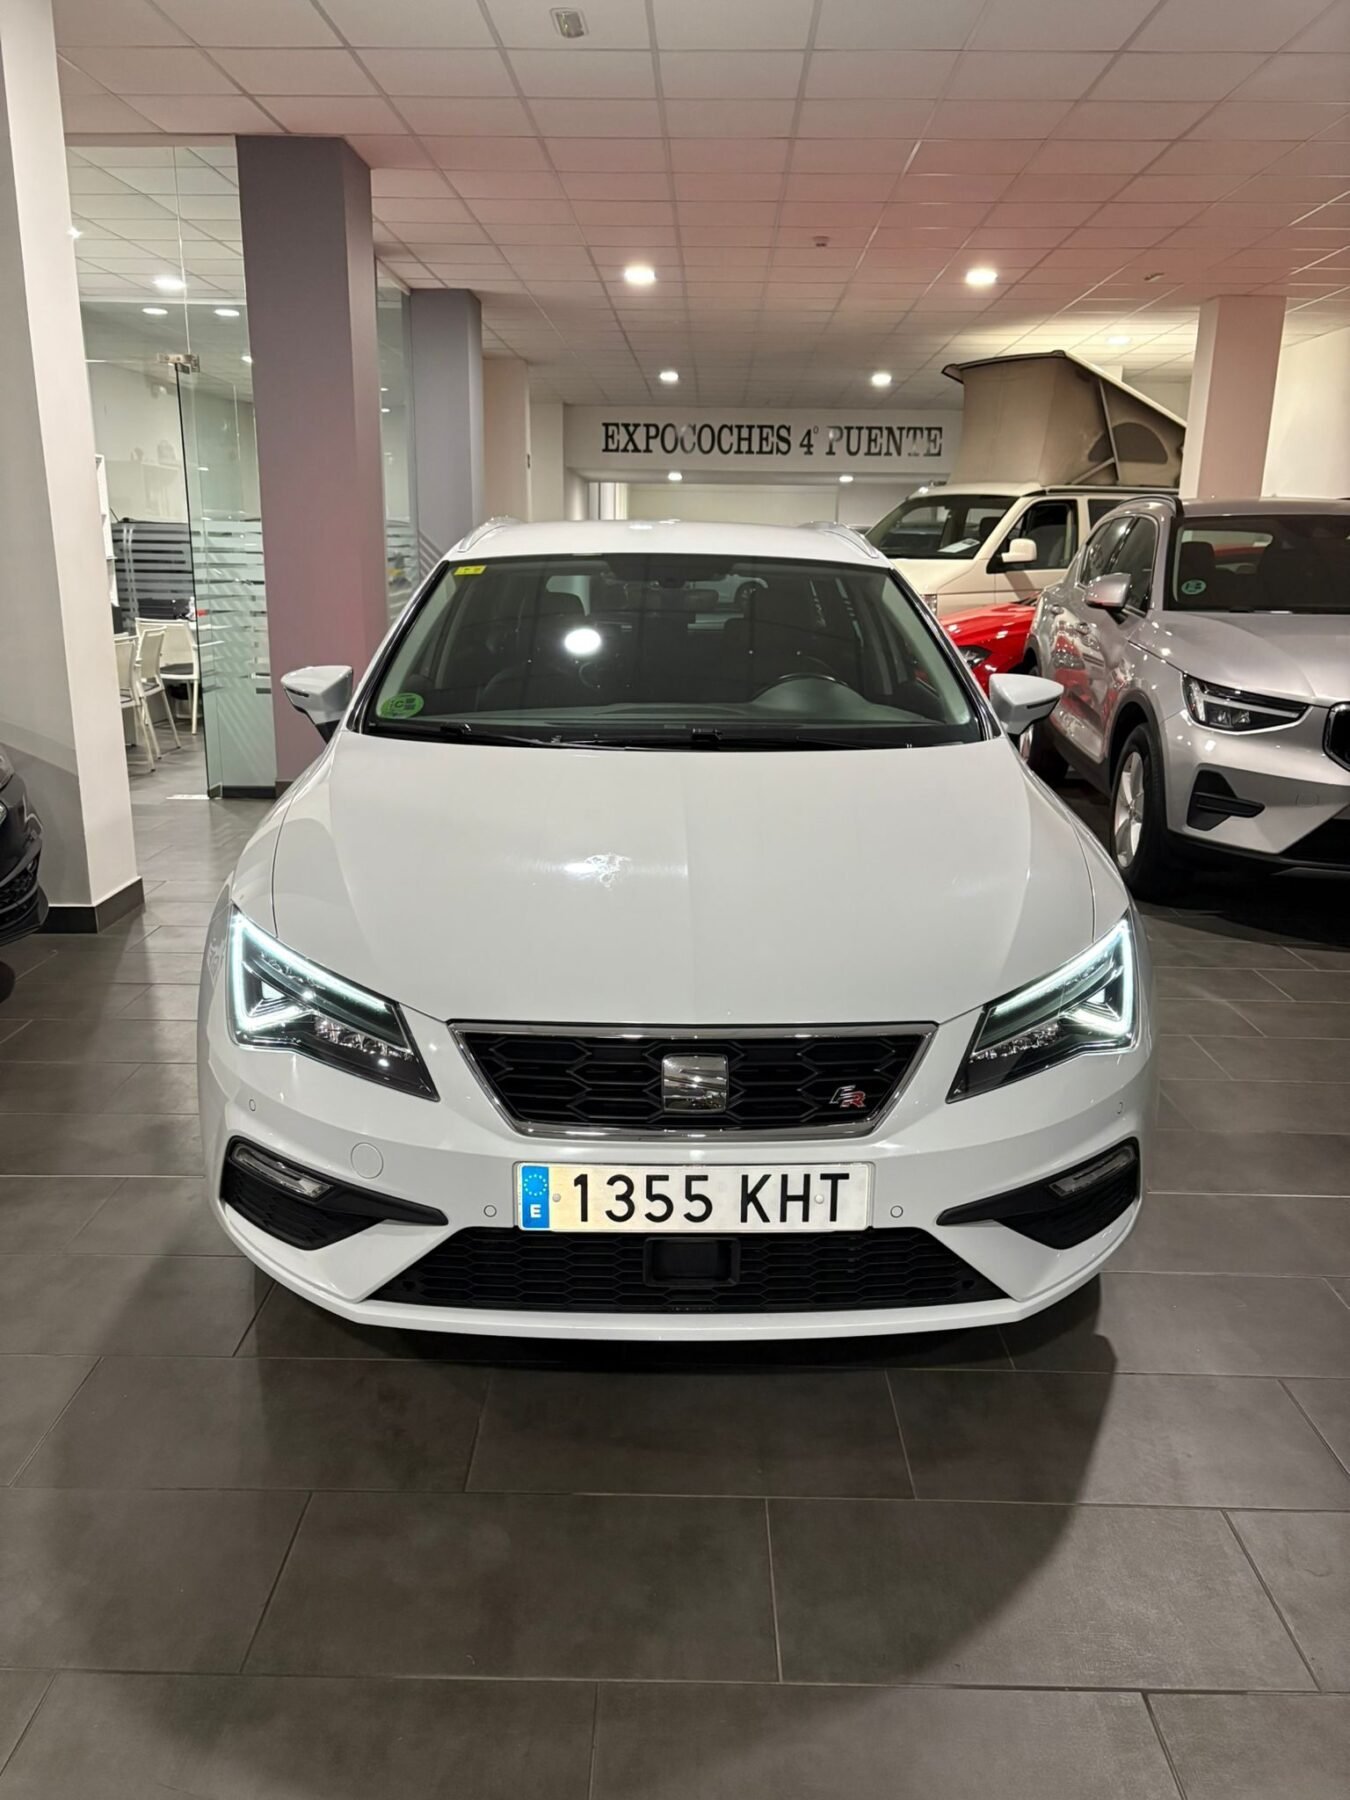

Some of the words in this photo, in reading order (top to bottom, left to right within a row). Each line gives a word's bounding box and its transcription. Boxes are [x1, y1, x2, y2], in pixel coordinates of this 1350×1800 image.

[602, 422, 791, 456] EXPOCOCHES
[825, 425, 943, 457] PUENTE
[530, 1204, 541, 1218] E
[574, 1173, 713, 1224] 1355
[740, 1173, 850, 1224] KHT
